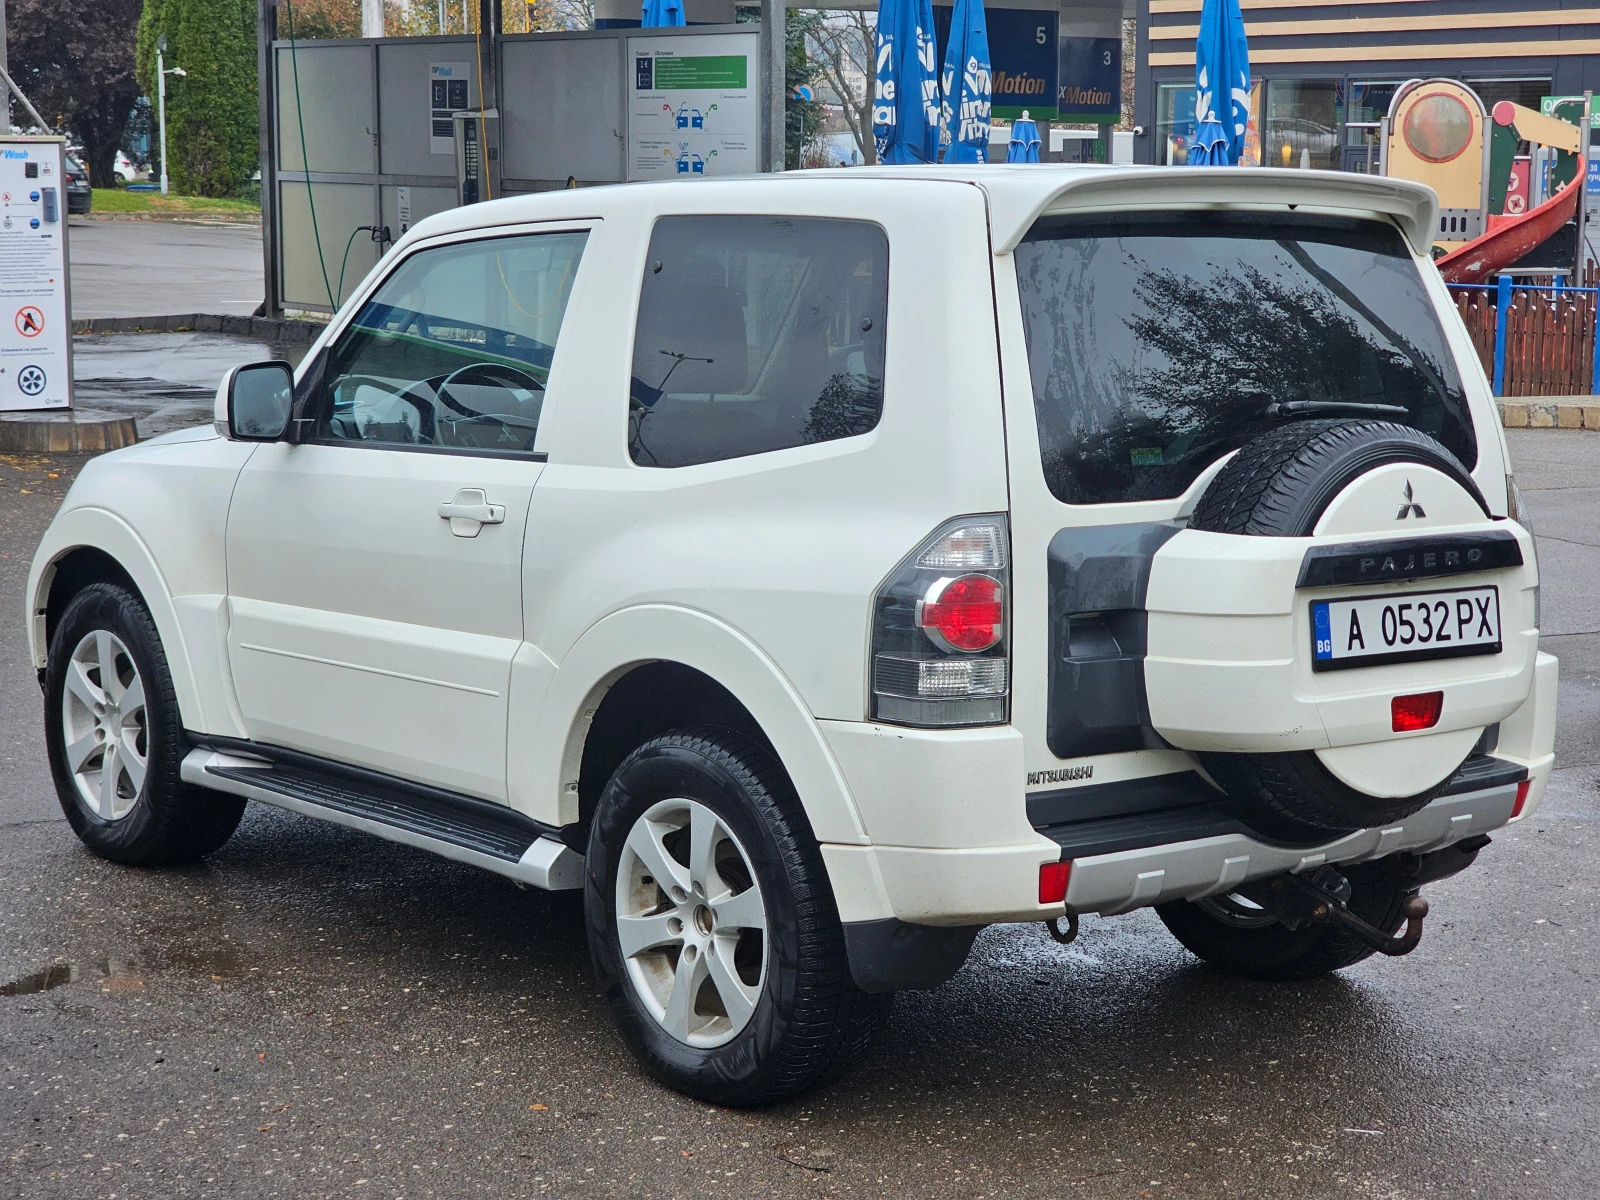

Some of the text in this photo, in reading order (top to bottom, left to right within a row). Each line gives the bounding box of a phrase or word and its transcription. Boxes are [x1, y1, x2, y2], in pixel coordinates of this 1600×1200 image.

[1036, 26, 1046, 44] 5
[1103, 51, 1111, 65] 3
[4, 150, 28, 159] Wash
[1590, 164, 1598, 172] 30
[1360, 548, 1483, 573] PAJERO
[1347, 608, 1365, 650] A
[1317, 640, 1331, 653] BG
[1027, 765, 1094, 786] MITSUBISHI
